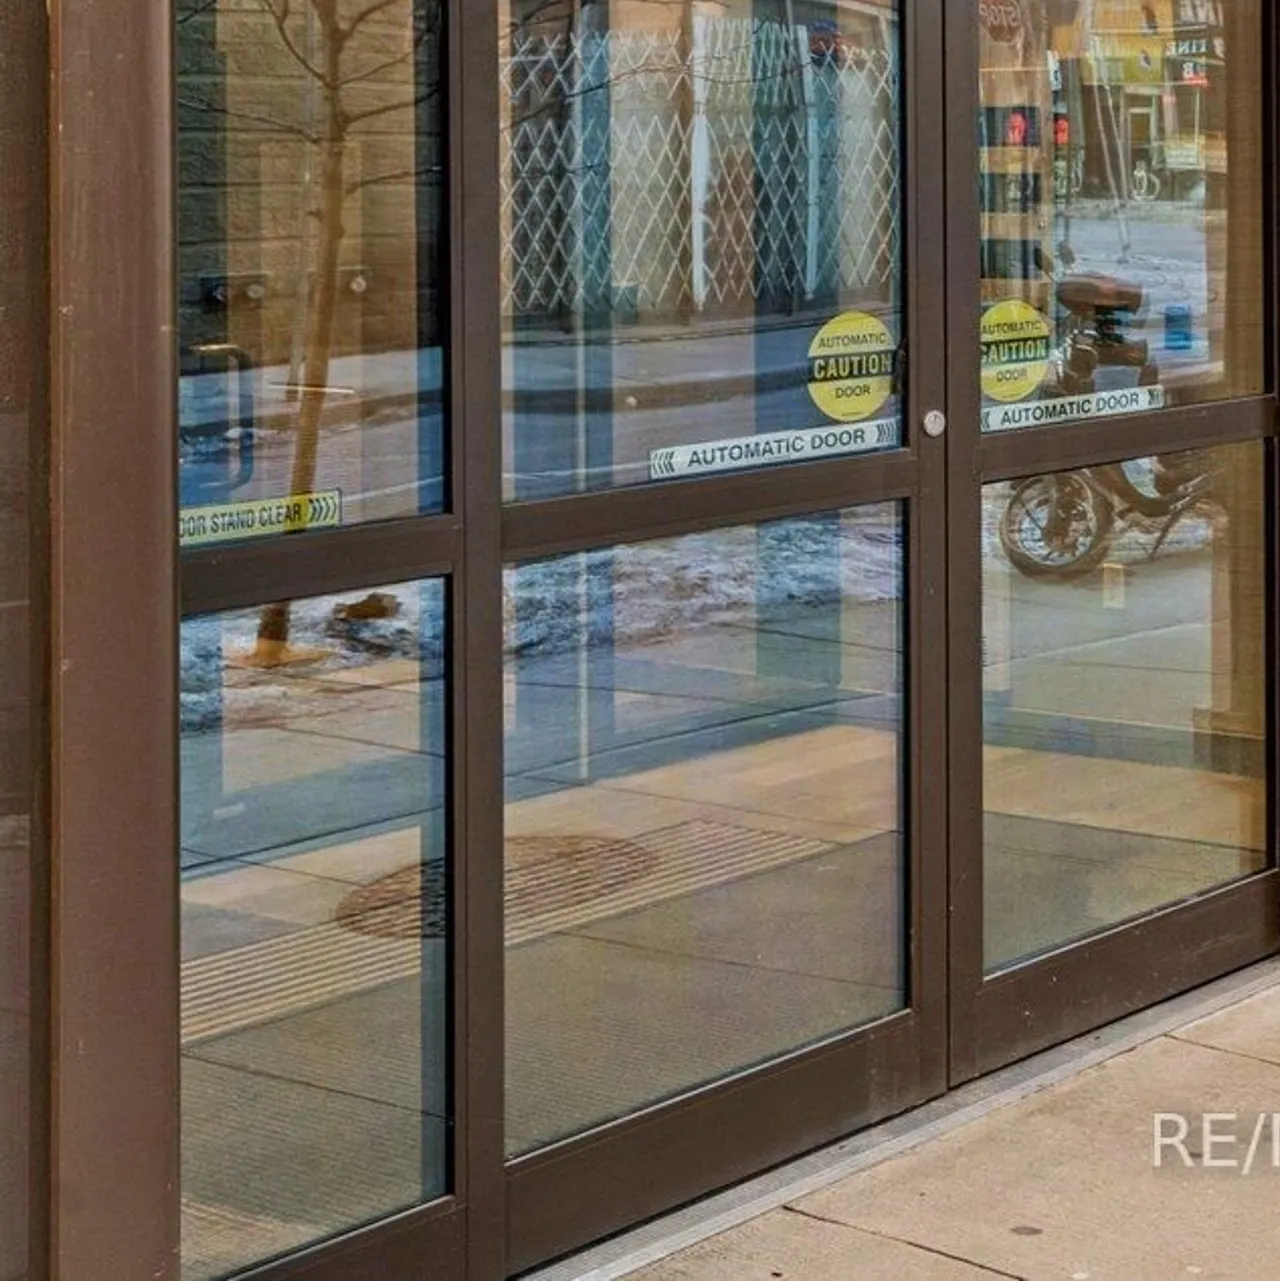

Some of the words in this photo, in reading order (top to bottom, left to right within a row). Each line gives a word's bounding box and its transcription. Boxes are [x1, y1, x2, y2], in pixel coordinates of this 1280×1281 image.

[982, 321, 1043, 336] AUTOMATIC
[818, 333, 887, 349] AUTOMATIC
[814, 354, 893, 379] CAUTION
[996, 369, 1028, 383] DOOR
[835, 385, 871, 399] DOOR
[1001, 399, 1091, 424] AUTOMATIC
[1097, 393, 1139, 410] DOOR
[687, 437, 804, 467] AUTOMATIC
[811, 429, 865, 447] DOOR
[210, 508, 256, 534] STAND
[260, 503, 301, 527] CLEAR
